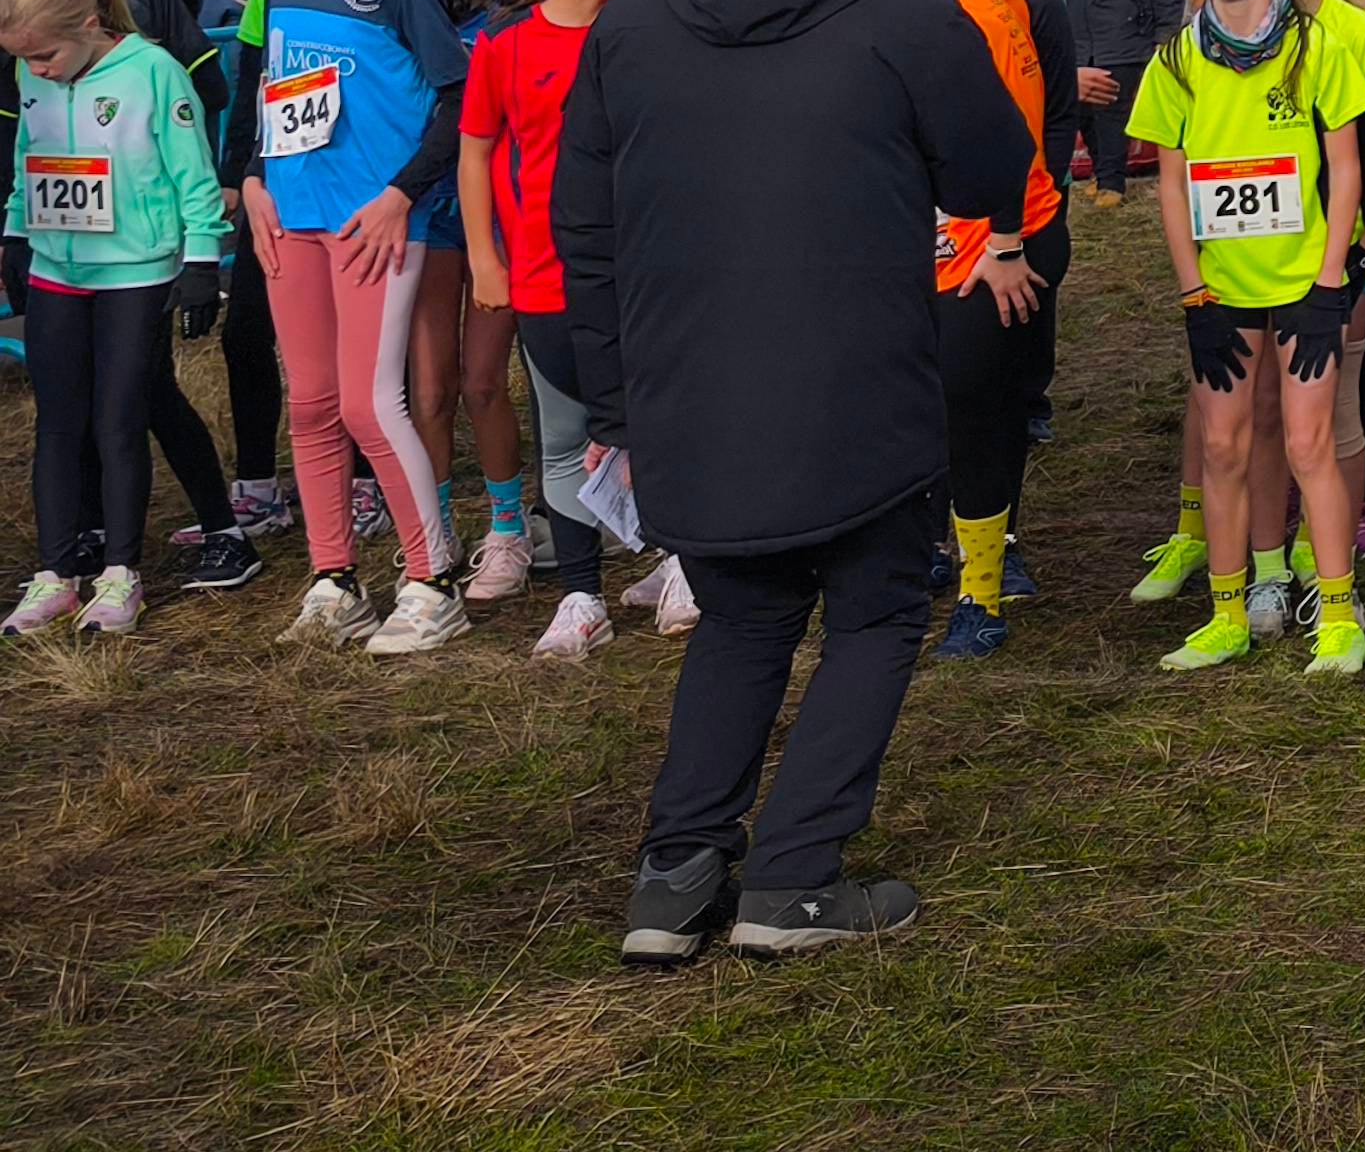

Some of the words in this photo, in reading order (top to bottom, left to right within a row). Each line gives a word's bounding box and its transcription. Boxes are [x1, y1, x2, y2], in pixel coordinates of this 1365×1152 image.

[281, 92, 330, 135] 344
[36, 177, 105, 211] 1201
[1215, 181, 1280, 217] 281
